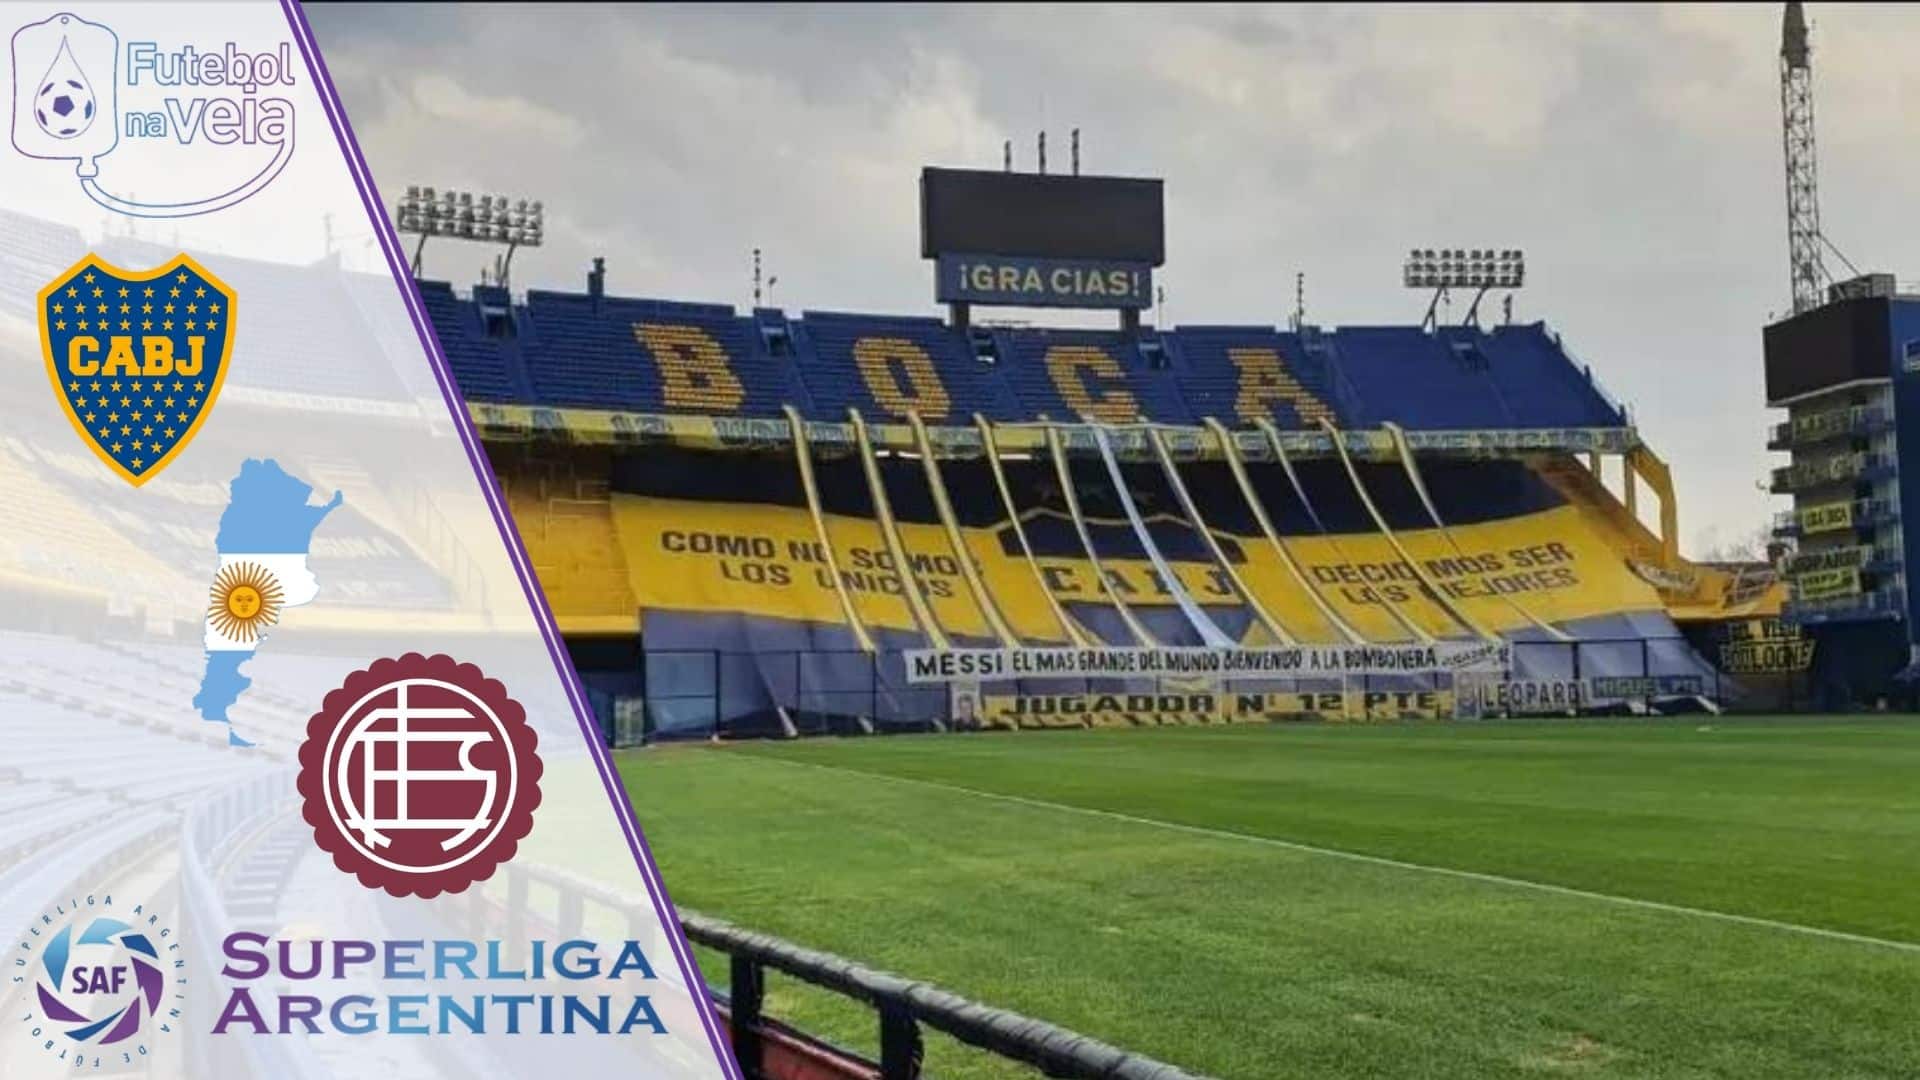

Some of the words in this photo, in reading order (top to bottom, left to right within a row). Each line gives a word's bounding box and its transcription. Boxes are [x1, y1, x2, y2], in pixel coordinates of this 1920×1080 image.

[632, 322, 1336, 427] BOCA
[660, 530, 775, 560] COMO
[850, 548, 983, 578] SOMO
[1312, 552, 1504, 585] DECIDMOS
[1509, 541, 1574, 568] SER
[719, 559, 792, 587] LOS
[915, 652, 1002, 677] MESSI
[1013, 651, 1031, 671] EL
[1036, 651, 1074, 671] MAS
[1079, 650, 1135, 671] GRANDE
[1139, 650, 1163, 670] DEL
[1165, 650, 1219, 671] MUNDO
[1310, 650, 1321, 670] A
[1324, 649, 1340, 669] LA
[1344, 647, 1437, 669] BOMBONERA
[1001, 694, 1214, 714] JUGADOR
